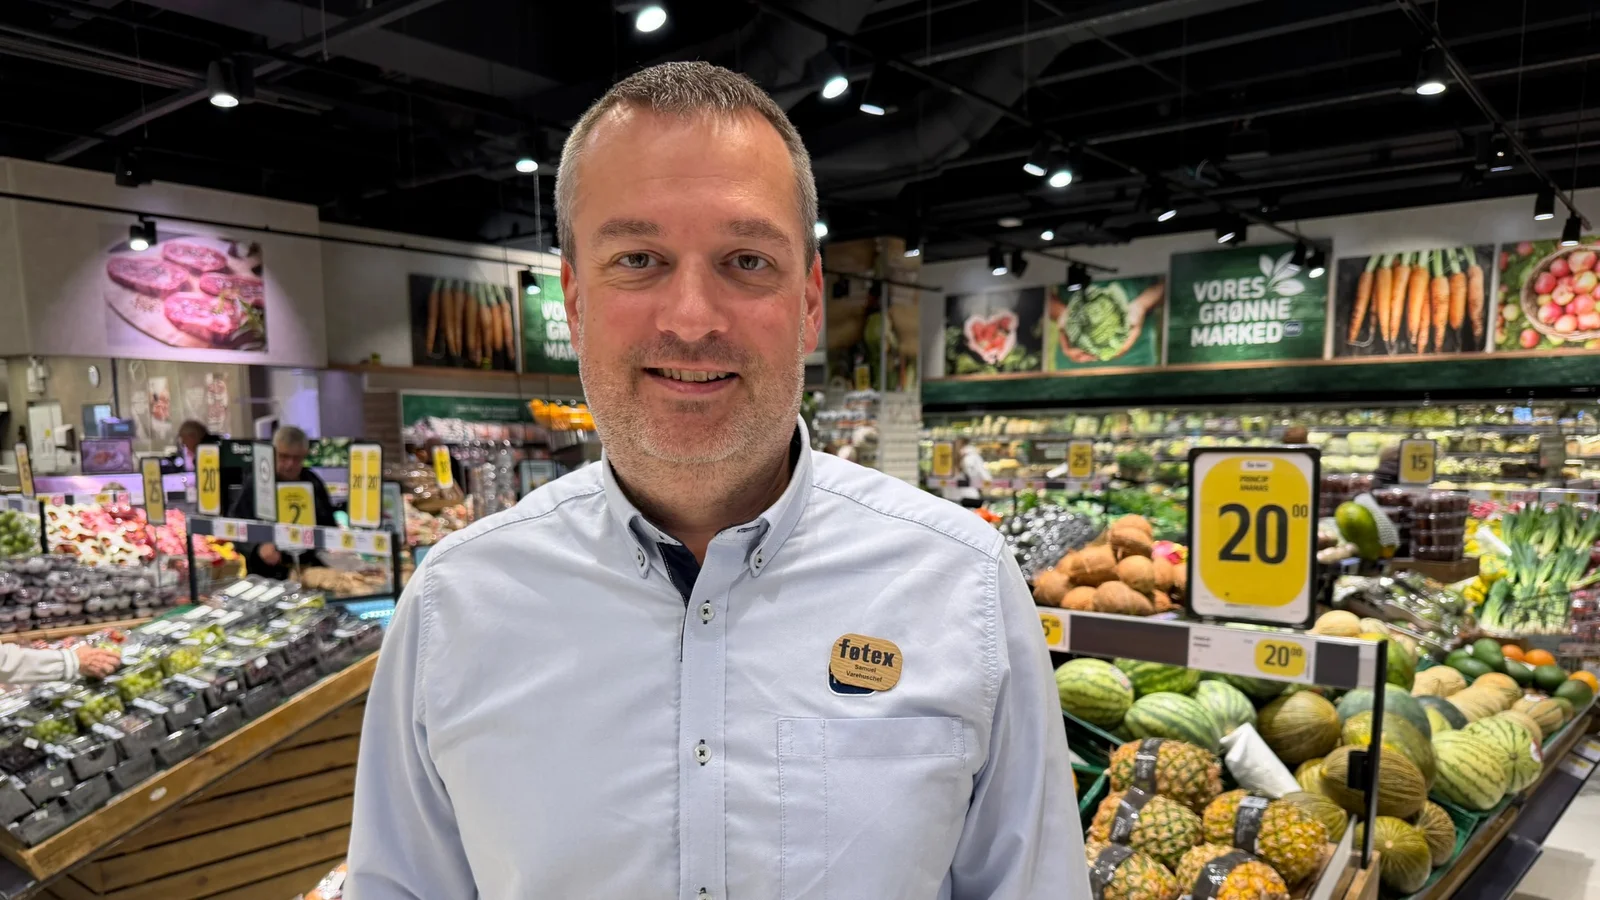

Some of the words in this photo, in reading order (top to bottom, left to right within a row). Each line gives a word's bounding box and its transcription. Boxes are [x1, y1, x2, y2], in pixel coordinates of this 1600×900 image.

[1192, 276, 1266, 302] VORES
[541, 301, 567, 322] VO
[1199, 298, 1292, 324] GRØNNE
[546, 320, 571, 341] GR
[1190, 321, 1284, 347] MARKED
[1411, 454, 1428, 471] 15
[202, 468, 216, 493] 20
[1218, 503, 1289, 565] 20
[1292, 504, 1308, 518] 00
[1041, 618, 1050, 637] 5
[839, 638, 895, 668] føtex
[1264, 644, 1290, 668] 20
[854, 664, 877, 673] Samuel
